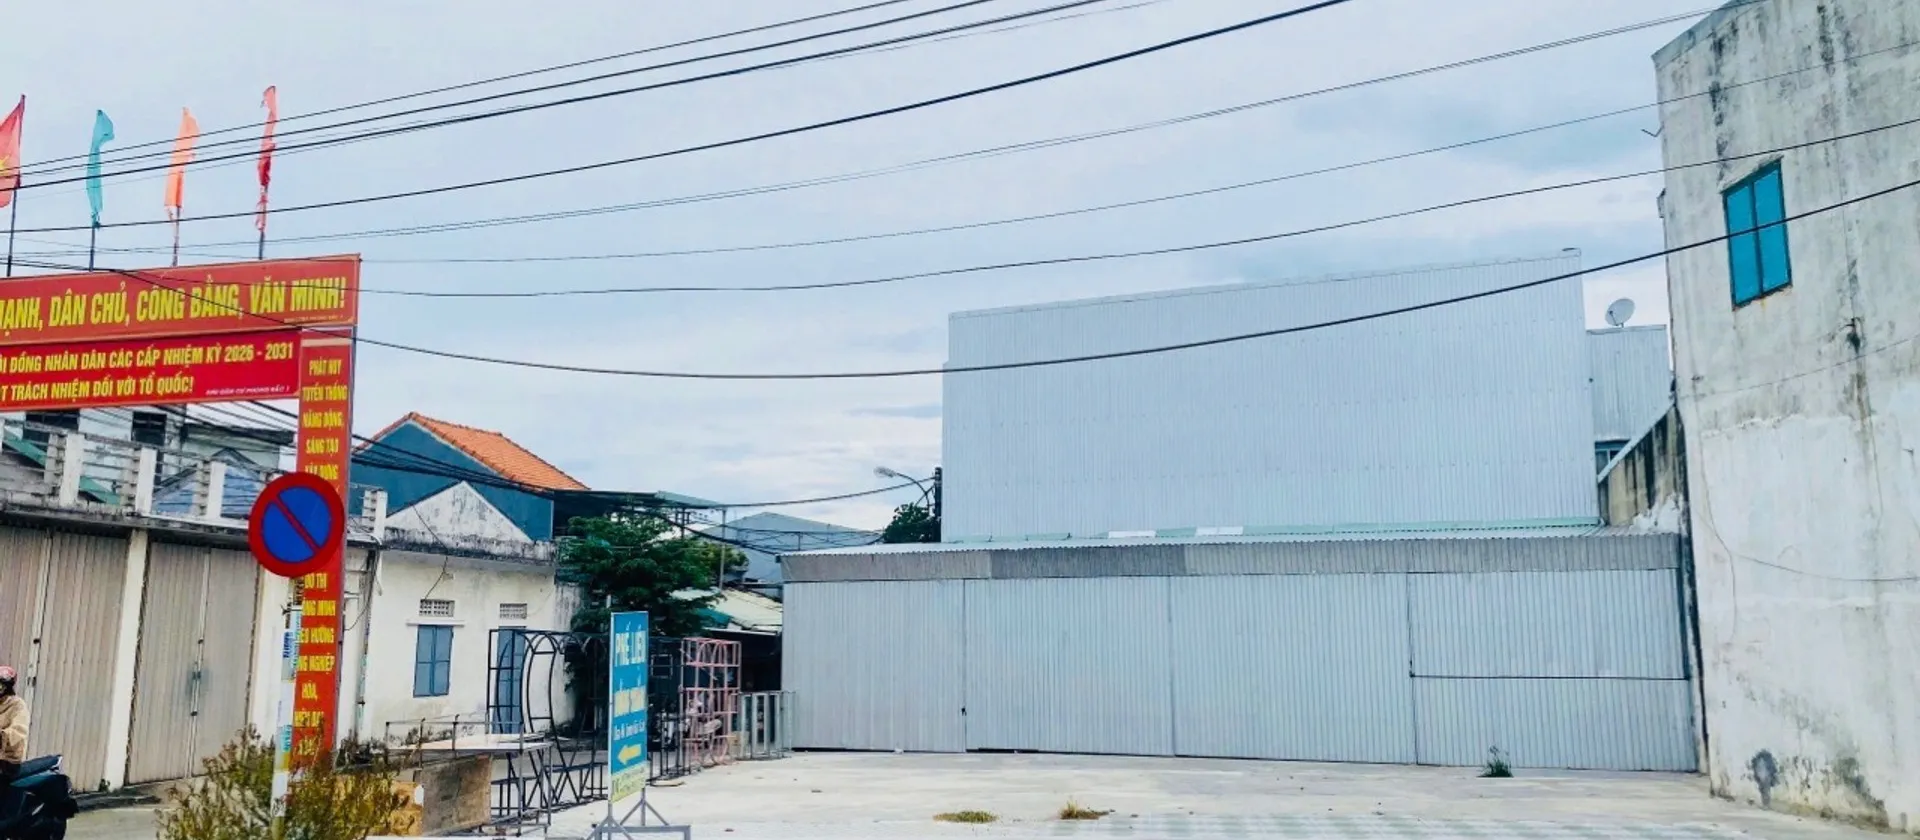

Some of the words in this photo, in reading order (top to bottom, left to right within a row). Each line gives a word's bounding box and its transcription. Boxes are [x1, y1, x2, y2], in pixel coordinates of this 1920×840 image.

[48, 288, 87, 328] DÂN
[90, 281, 131, 327] CHỦ,
[136, 284, 186, 322] CÔNG
[190, 274, 244, 319] BẰNG,
[249, 275, 286, 315] VĂN
[289, 275, 347, 312] MINH!
[44, 349, 79, 372] NHÂN
[81, 348, 106, 370] DÂN
[109, 347, 133, 368] CÁC
[136, 343, 161, 367] CẤP
[163, 344, 204, 369] NHIỆM
[206, 341, 222, 364] KỲ
[224, 343, 255, 363] 2026
[264, 341, 293, 361] 2031
[11, 381, 49, 402] TRÁCH
[51, 377, 91, 403] NHIỆM
[93, 373, 113, 398] ĐỐI
[116, 374, 136, 397] VỚI
[139, 371, 157, 394] TỔ
[157, 369, 194, 396] QUỐC!
